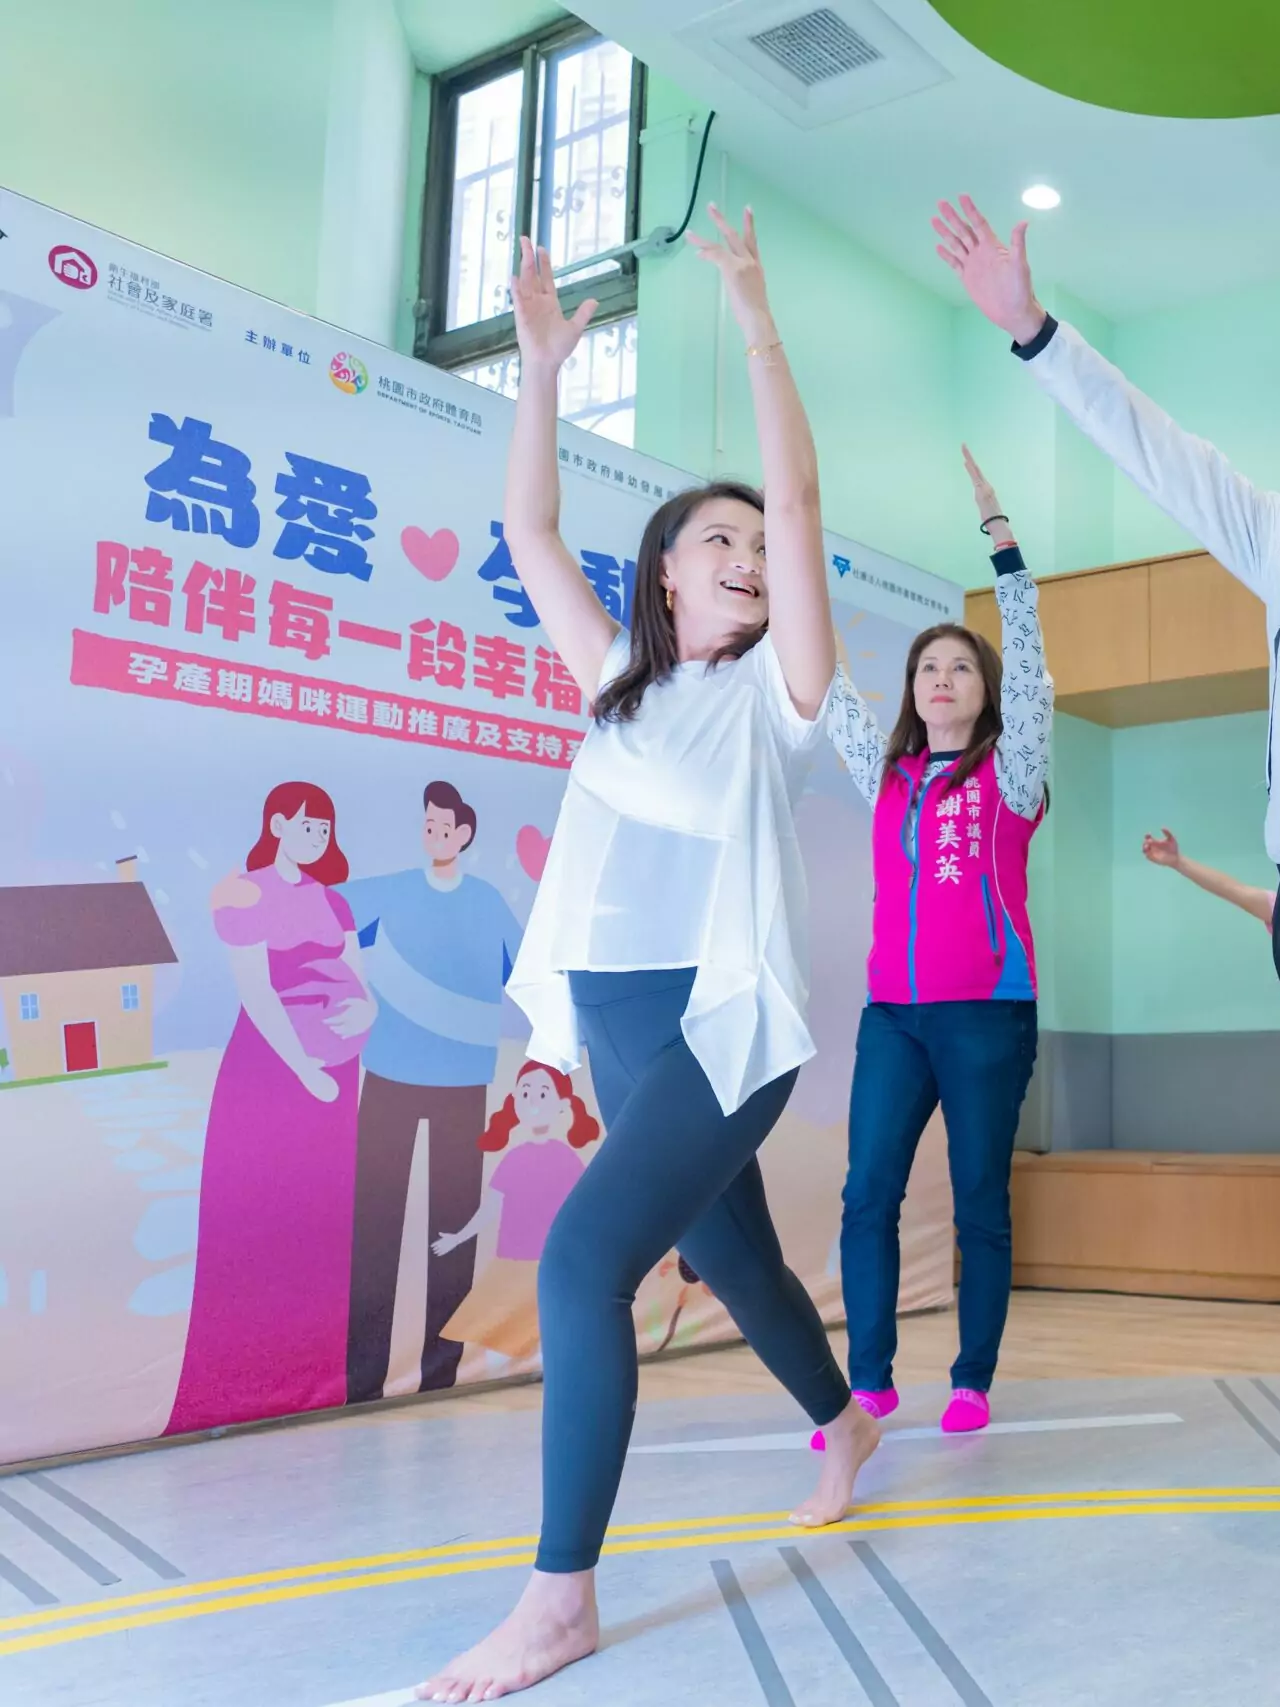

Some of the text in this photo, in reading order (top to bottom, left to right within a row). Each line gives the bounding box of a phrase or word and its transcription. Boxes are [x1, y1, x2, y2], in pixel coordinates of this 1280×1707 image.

[107, 274, 213, 328] 社會及家庭署
[245, 329, 312, 365] 主辦單位
[379, 376, 482, 427] 桃園市政府體育局
[144, 412, 378, 582] 為愛
[93, 541, 594, 719] 陪伴每一段幸福
[934, 793, 964, 885] 謝美英
[964, 776, 982, 859] 桃園市議員
